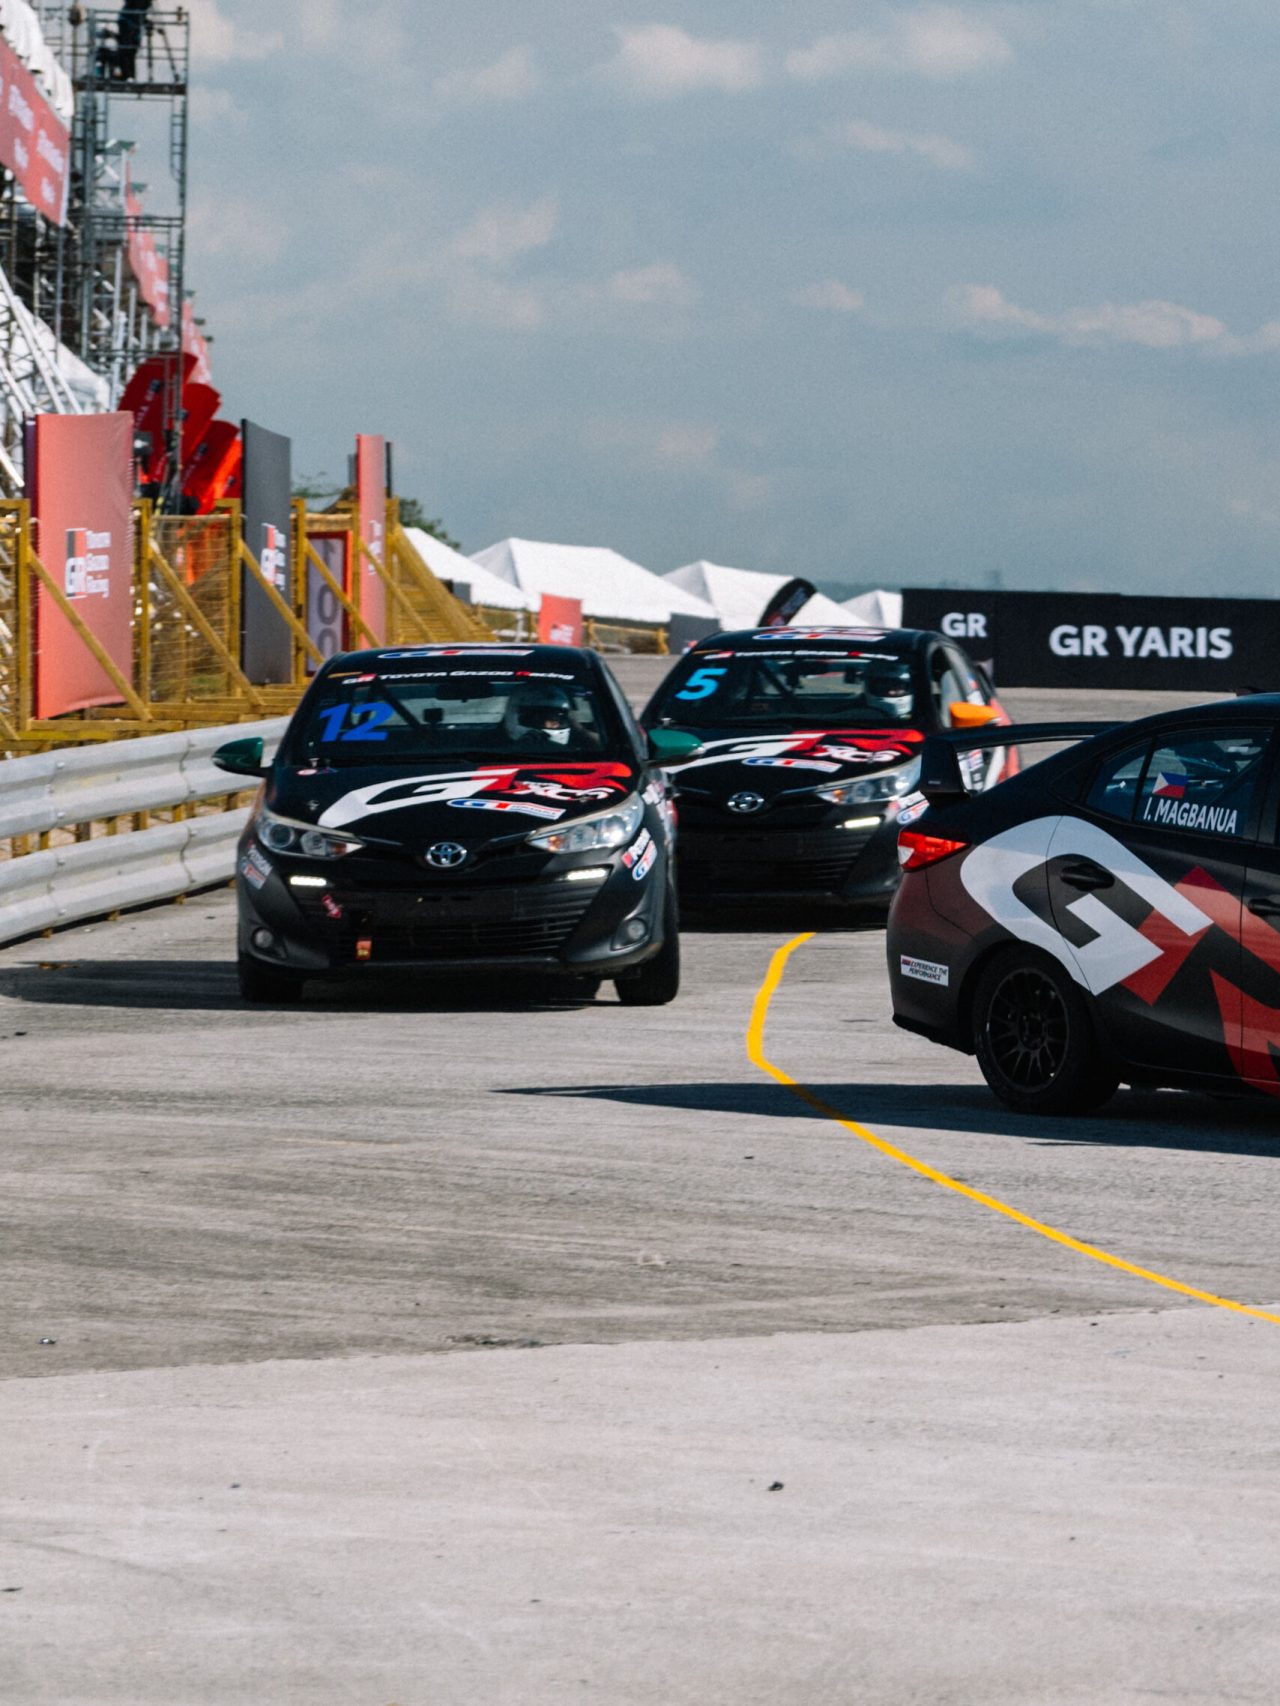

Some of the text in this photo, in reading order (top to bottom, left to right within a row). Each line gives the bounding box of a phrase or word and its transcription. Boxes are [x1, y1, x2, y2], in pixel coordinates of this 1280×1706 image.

[940, 611, 988, 638] GR
[1048, 624, 1234, 660] GR YARIS
[378, 671, 448, 681] TOYOTA
[515, 671, 575, 681] Racing
[674, 667, 728, 701] 5
[319, 701, 395, 742] 12
[1143, 796, 1238, 834] I. MAGBANUA
